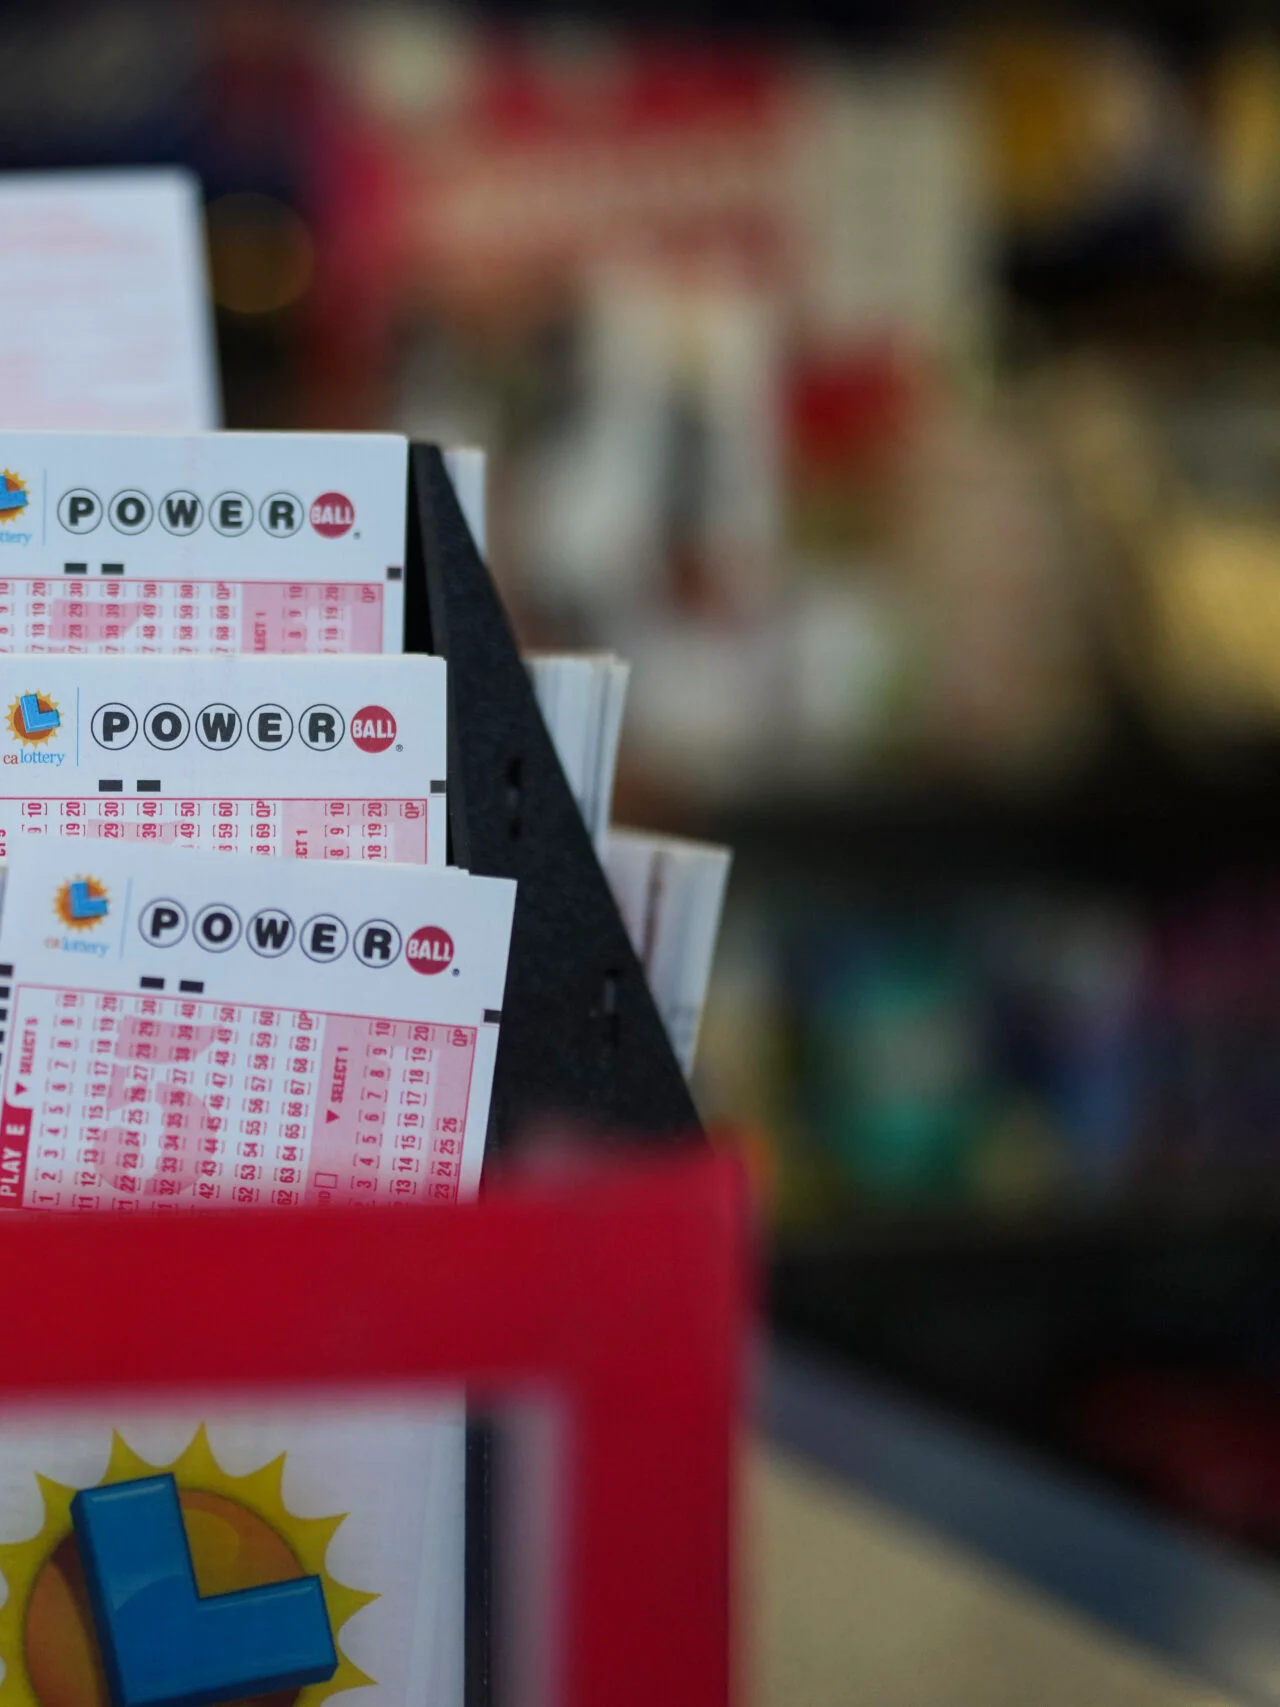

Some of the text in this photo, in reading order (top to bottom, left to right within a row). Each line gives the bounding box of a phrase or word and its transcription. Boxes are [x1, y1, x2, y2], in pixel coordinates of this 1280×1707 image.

[68, 496, 295, 530] POWER
[102, 710, 394, 743] POWER BALL
[3, 749, 65, 766] ca lottery
[219, 802, 233, 817] 60
[405, 801, 419, 819] QP
[66, 802, 80, 836] 19 20
[104, 802, 119, 838] 29 30
[143, 802, 157, 838] 39 40
[181, 802, 195, 838] 49 50
[256, 800, 270, 838] 69 QP
[219, 823, 233, 838] 59
[330, 802, 344, 857] 8 9 10
[368, 802, 382, 859] 18 19 20
[150, 907, 451, 961] POWER BALL
[142, 1000, 157, 1014] 30
[181, 1004, 195, 1018] 40
[100, 1017, 114, 1032] 19
[139, 1021, 153, 1036] 29
[178, 1025, 192, 1040] 39
[452, 1028, 467, 1047] QP
[19, 1030, 36, 1076] SELECT
[136, 1043, 151, 1058] 28
[175, 1047, 190, 1062] 38
[94, 1061, 108, 1075] 17
[134, 1065, 148, 1081] 27
[172, 1069, 187, 1085] 37
[331, 1056, 348, 1104] SELECT
[92, 1084, 106, 1097] 16
[130, 1087, 146, 1102] 26
[170, 1091, 185, 1106] 36
[199, 1007, 235, 1199] 42 43 44 45 46 47 48 49 50
[238, 1011, 274, 1203] 52 53 54 55 56 57 58 59 60
[277, 1011, 313, 1205] 62 63 64 65 66 67 68 69 QP
[357, 1022, 390, 1189] 3 4 5 6 7 8 9 10
[395, 1027, 429, 1194] 13 14 15 16 17 18 19 20
[89, 1105, 104, 1119] 15
[128, 1109, 143, 1124] 25
[167, 1113, 182, 1128] 35
[87, 1128, 101, 1141] 14
[124, 1131, 140, 1147] 24
[165, 1135, 179, 1150] 34
[0, 1124, 25, 1198] PLAY E
[84, 1149, 99, 1163] 13
[122, 1153, 138, 1168] 23
[434, 1118, 457, 1200] 23 24 25 26
[162, 1157, 177, 1173] 33
[81, 1172, 95, 1186] 12
[120, 1175, 136, 1192] 22
[160, 1179, 176, 1195] 32
